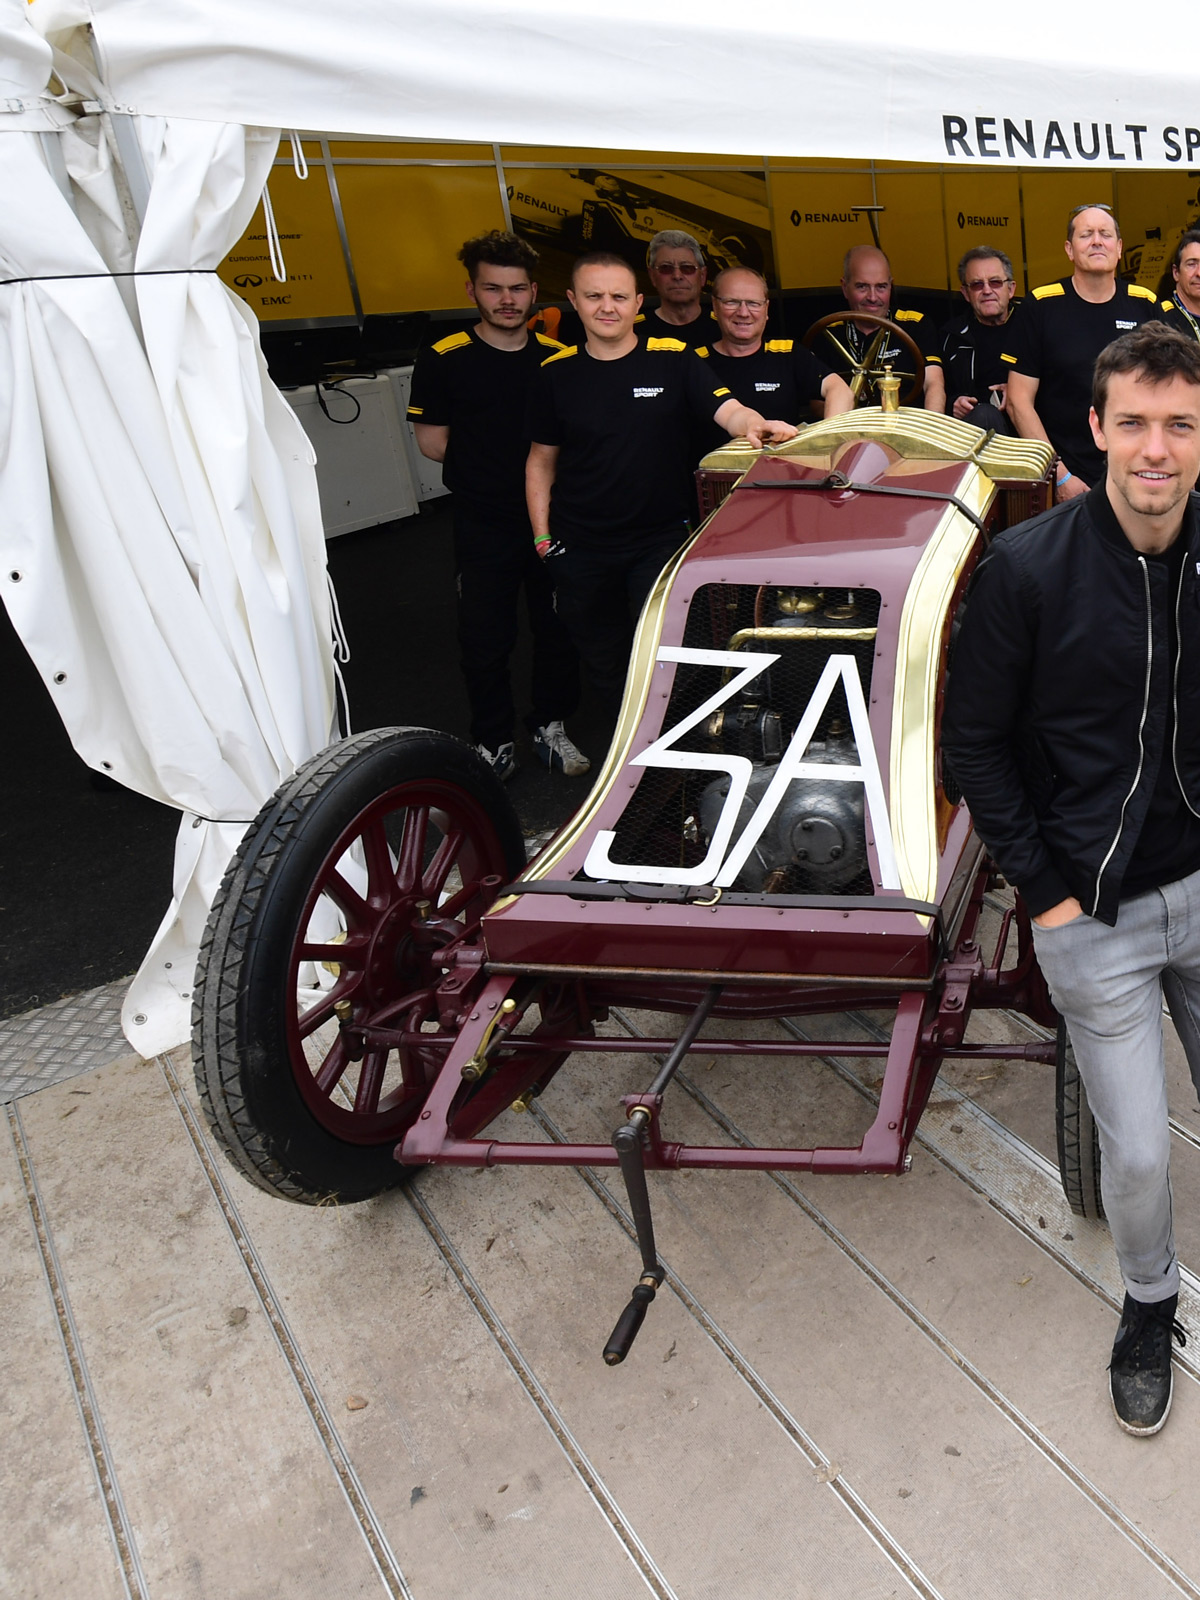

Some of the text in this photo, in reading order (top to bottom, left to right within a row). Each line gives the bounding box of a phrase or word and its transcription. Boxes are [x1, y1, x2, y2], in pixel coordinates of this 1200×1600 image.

[942, 114, 1148, 162] RENAULT
[516, 192, 570, 217] RENAULT
[805, 214, 860, 223] RENAULT
[967, 216, 1009, 226] RENAULT
[265, 274, 313, 282] ININITI
[583, 645, 902, 892] 3A
